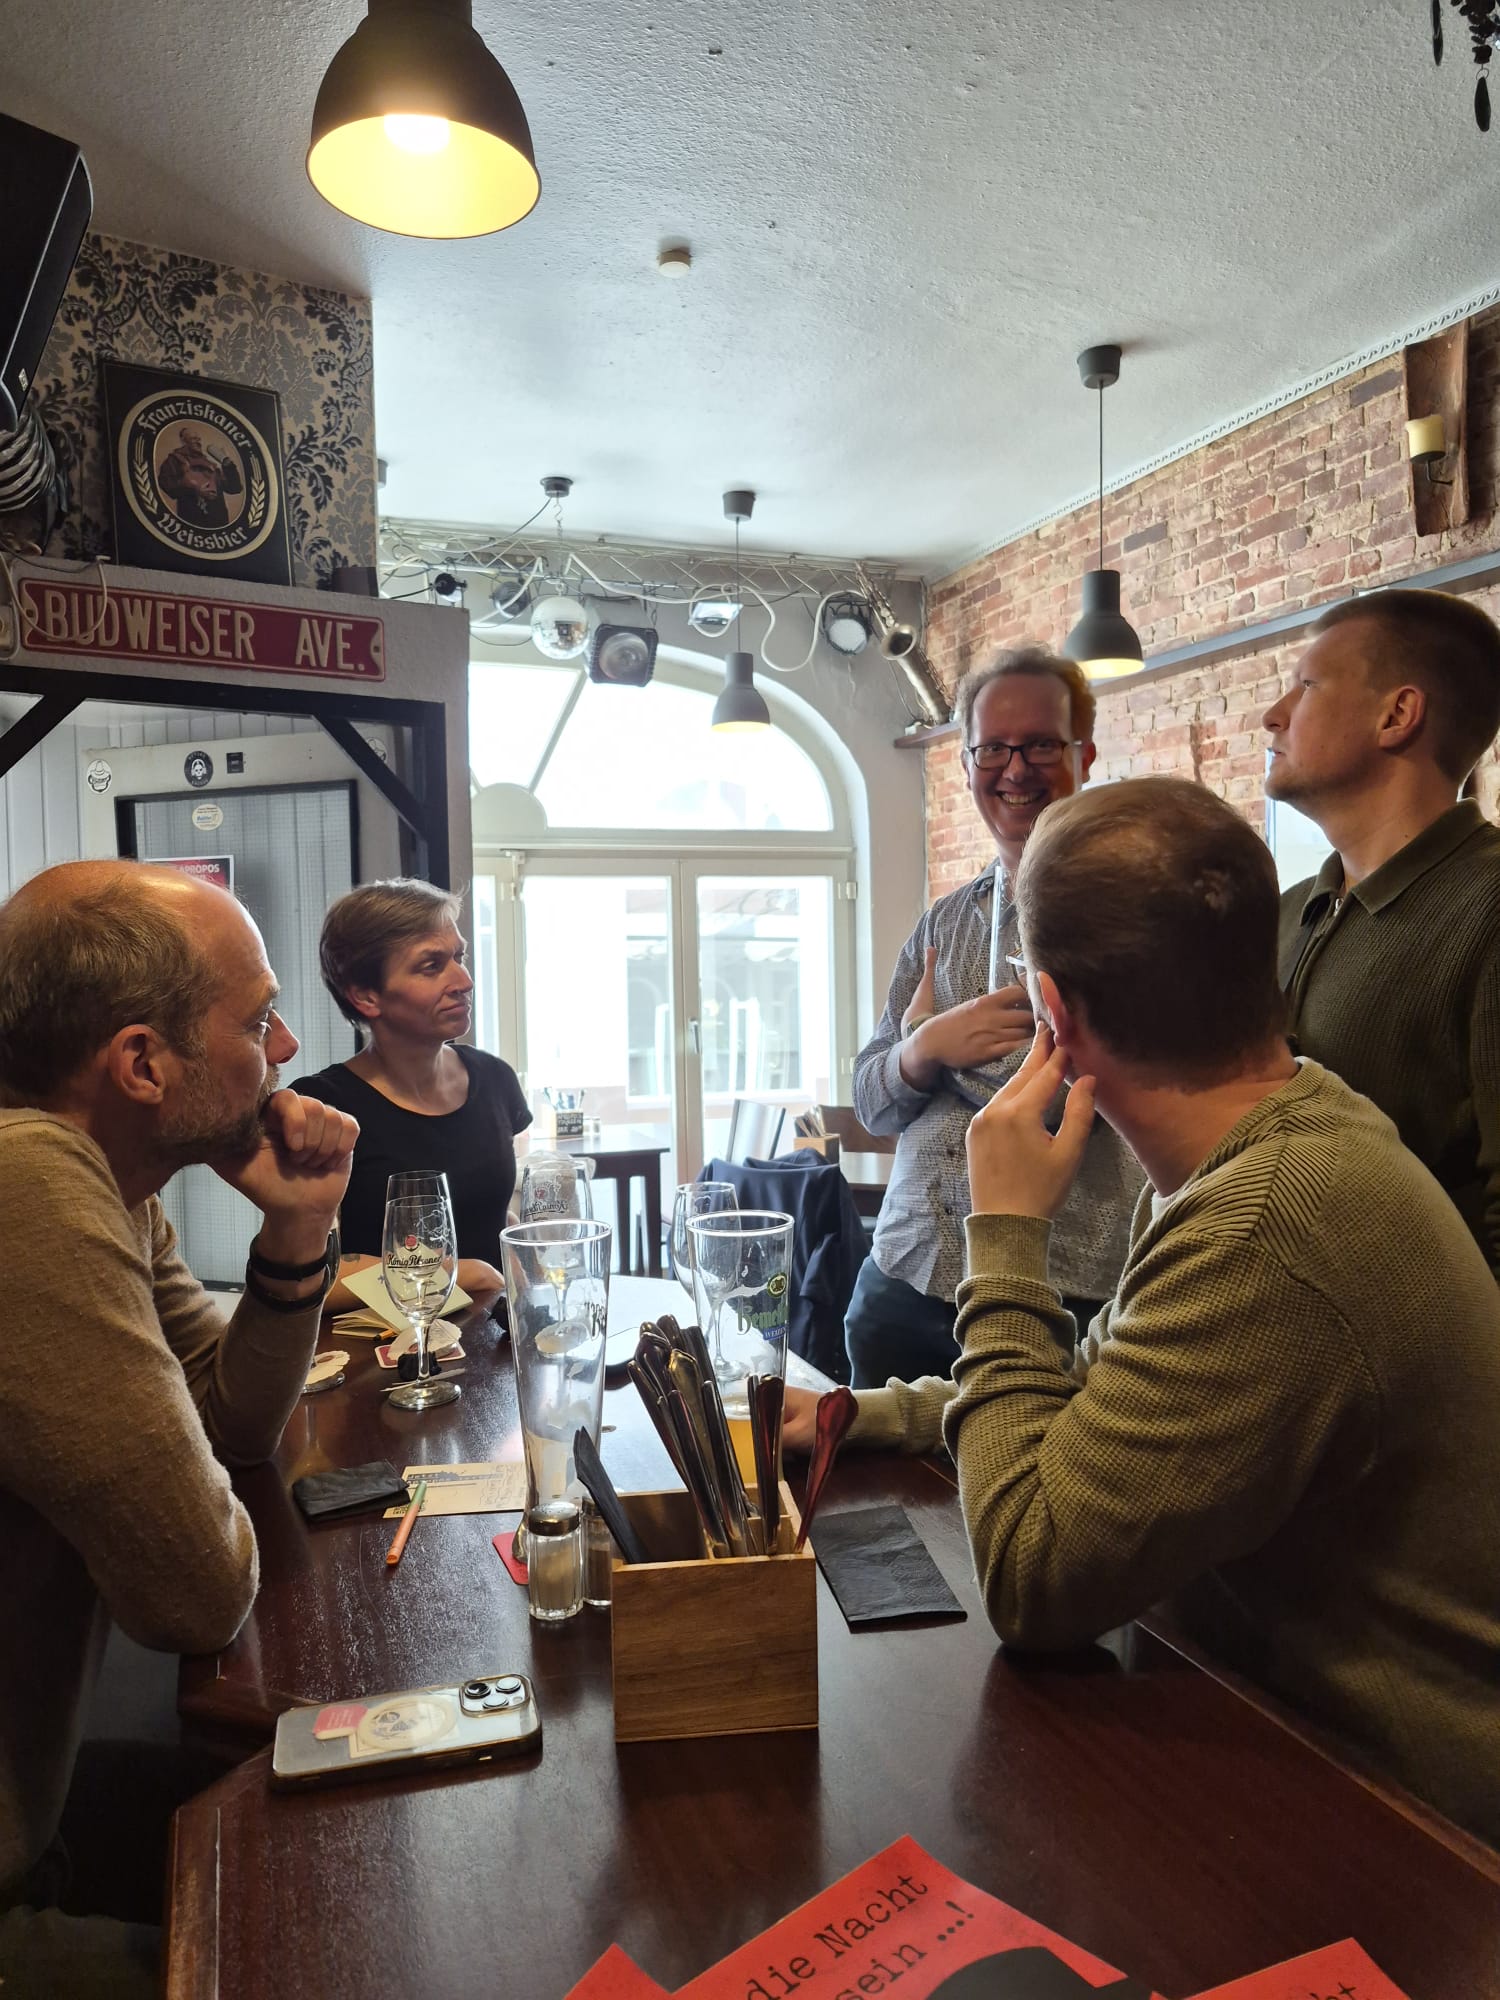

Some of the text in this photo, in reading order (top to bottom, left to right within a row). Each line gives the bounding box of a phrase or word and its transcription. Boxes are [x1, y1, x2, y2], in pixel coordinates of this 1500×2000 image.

[137, 400, 252, 448] Franziskaner
[157, 513, 248, 549] Weissbier
[44, 589, 366, 672] BUDWEISER AVE.
[387, 1253, 410, 1269] König
[746, 1874, 928, 2000] die Nacht
